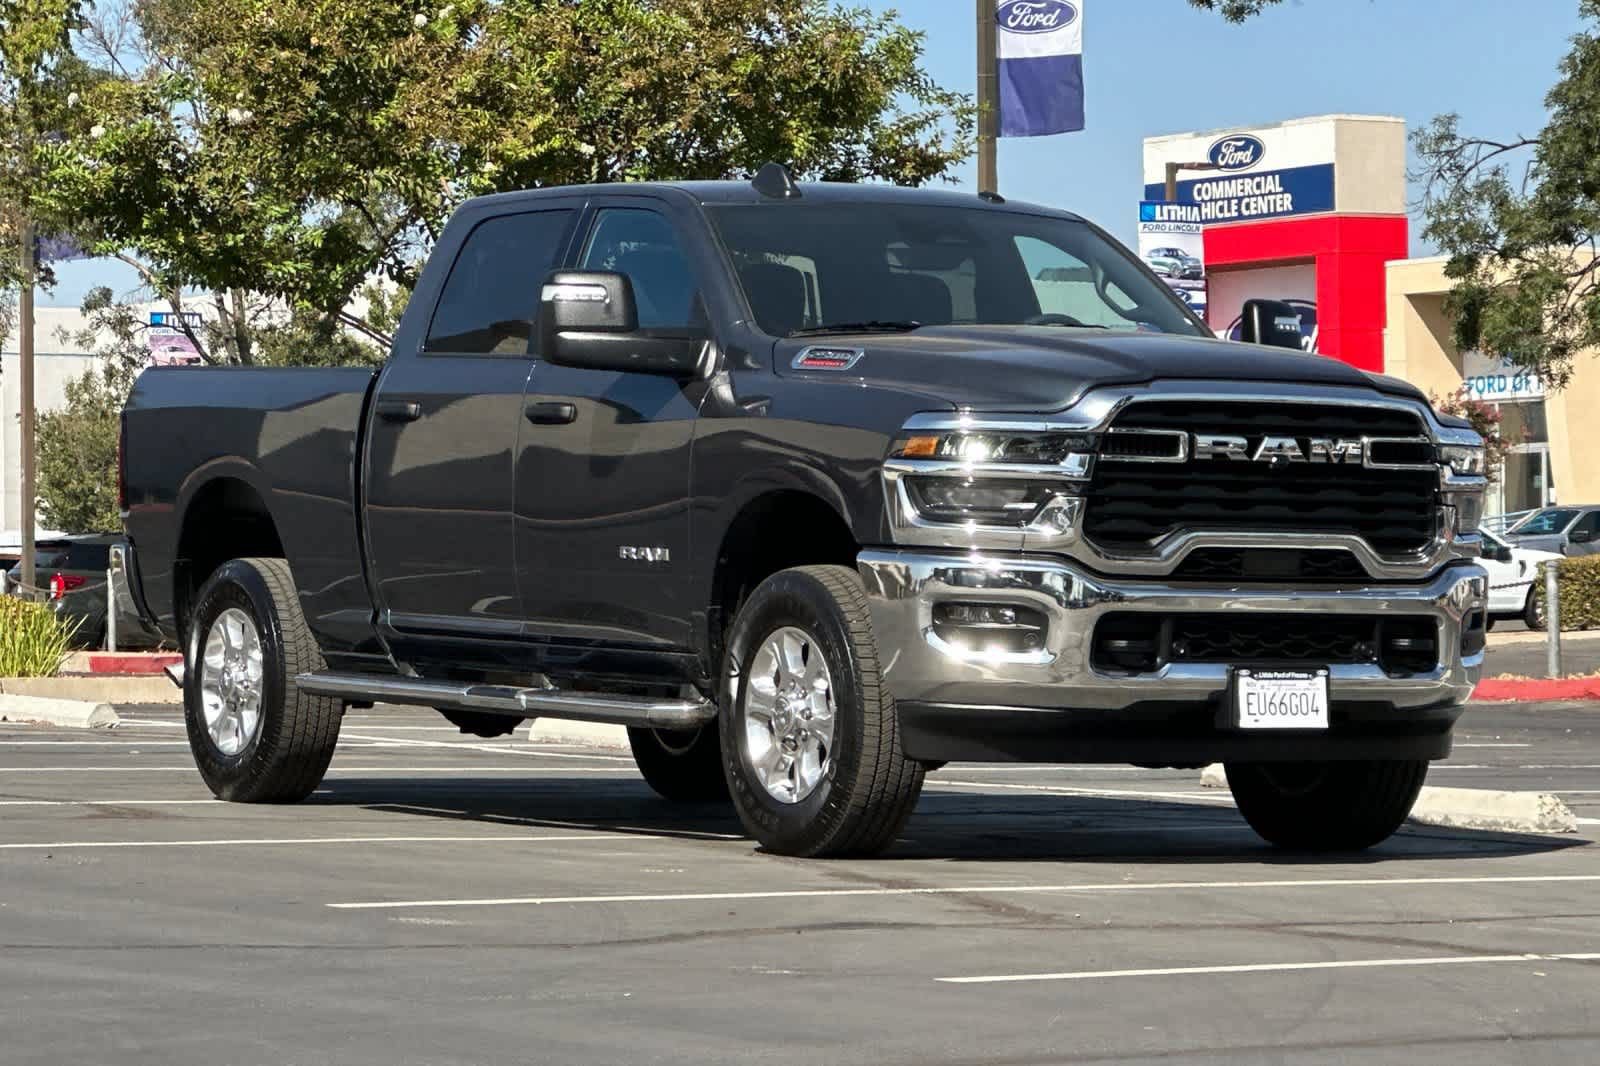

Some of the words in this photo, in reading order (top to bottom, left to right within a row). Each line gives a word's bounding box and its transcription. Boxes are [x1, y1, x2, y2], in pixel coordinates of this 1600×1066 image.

[1007, 2, 1061, 27] Ford
[1218, 140, 1254, 166] Ford
[1193, 174, 1284, 201] COMMERCIAL
[1155, 204, 1201, 222] LITHIA
[1201, 199, 1239, 220] HICLE
[1241, 193, 1293, 216] CENTER
[1142, 223, 1167, 232] FORD
[1168, 223, 1200, 233] LINCOLN
[1465, 374, 1507, 394] FORD
[1193, 434, 1362, 464] RAM
[619, 545, 671, 562] RAM
[1246, 692, 1320, 716] EU66G04
